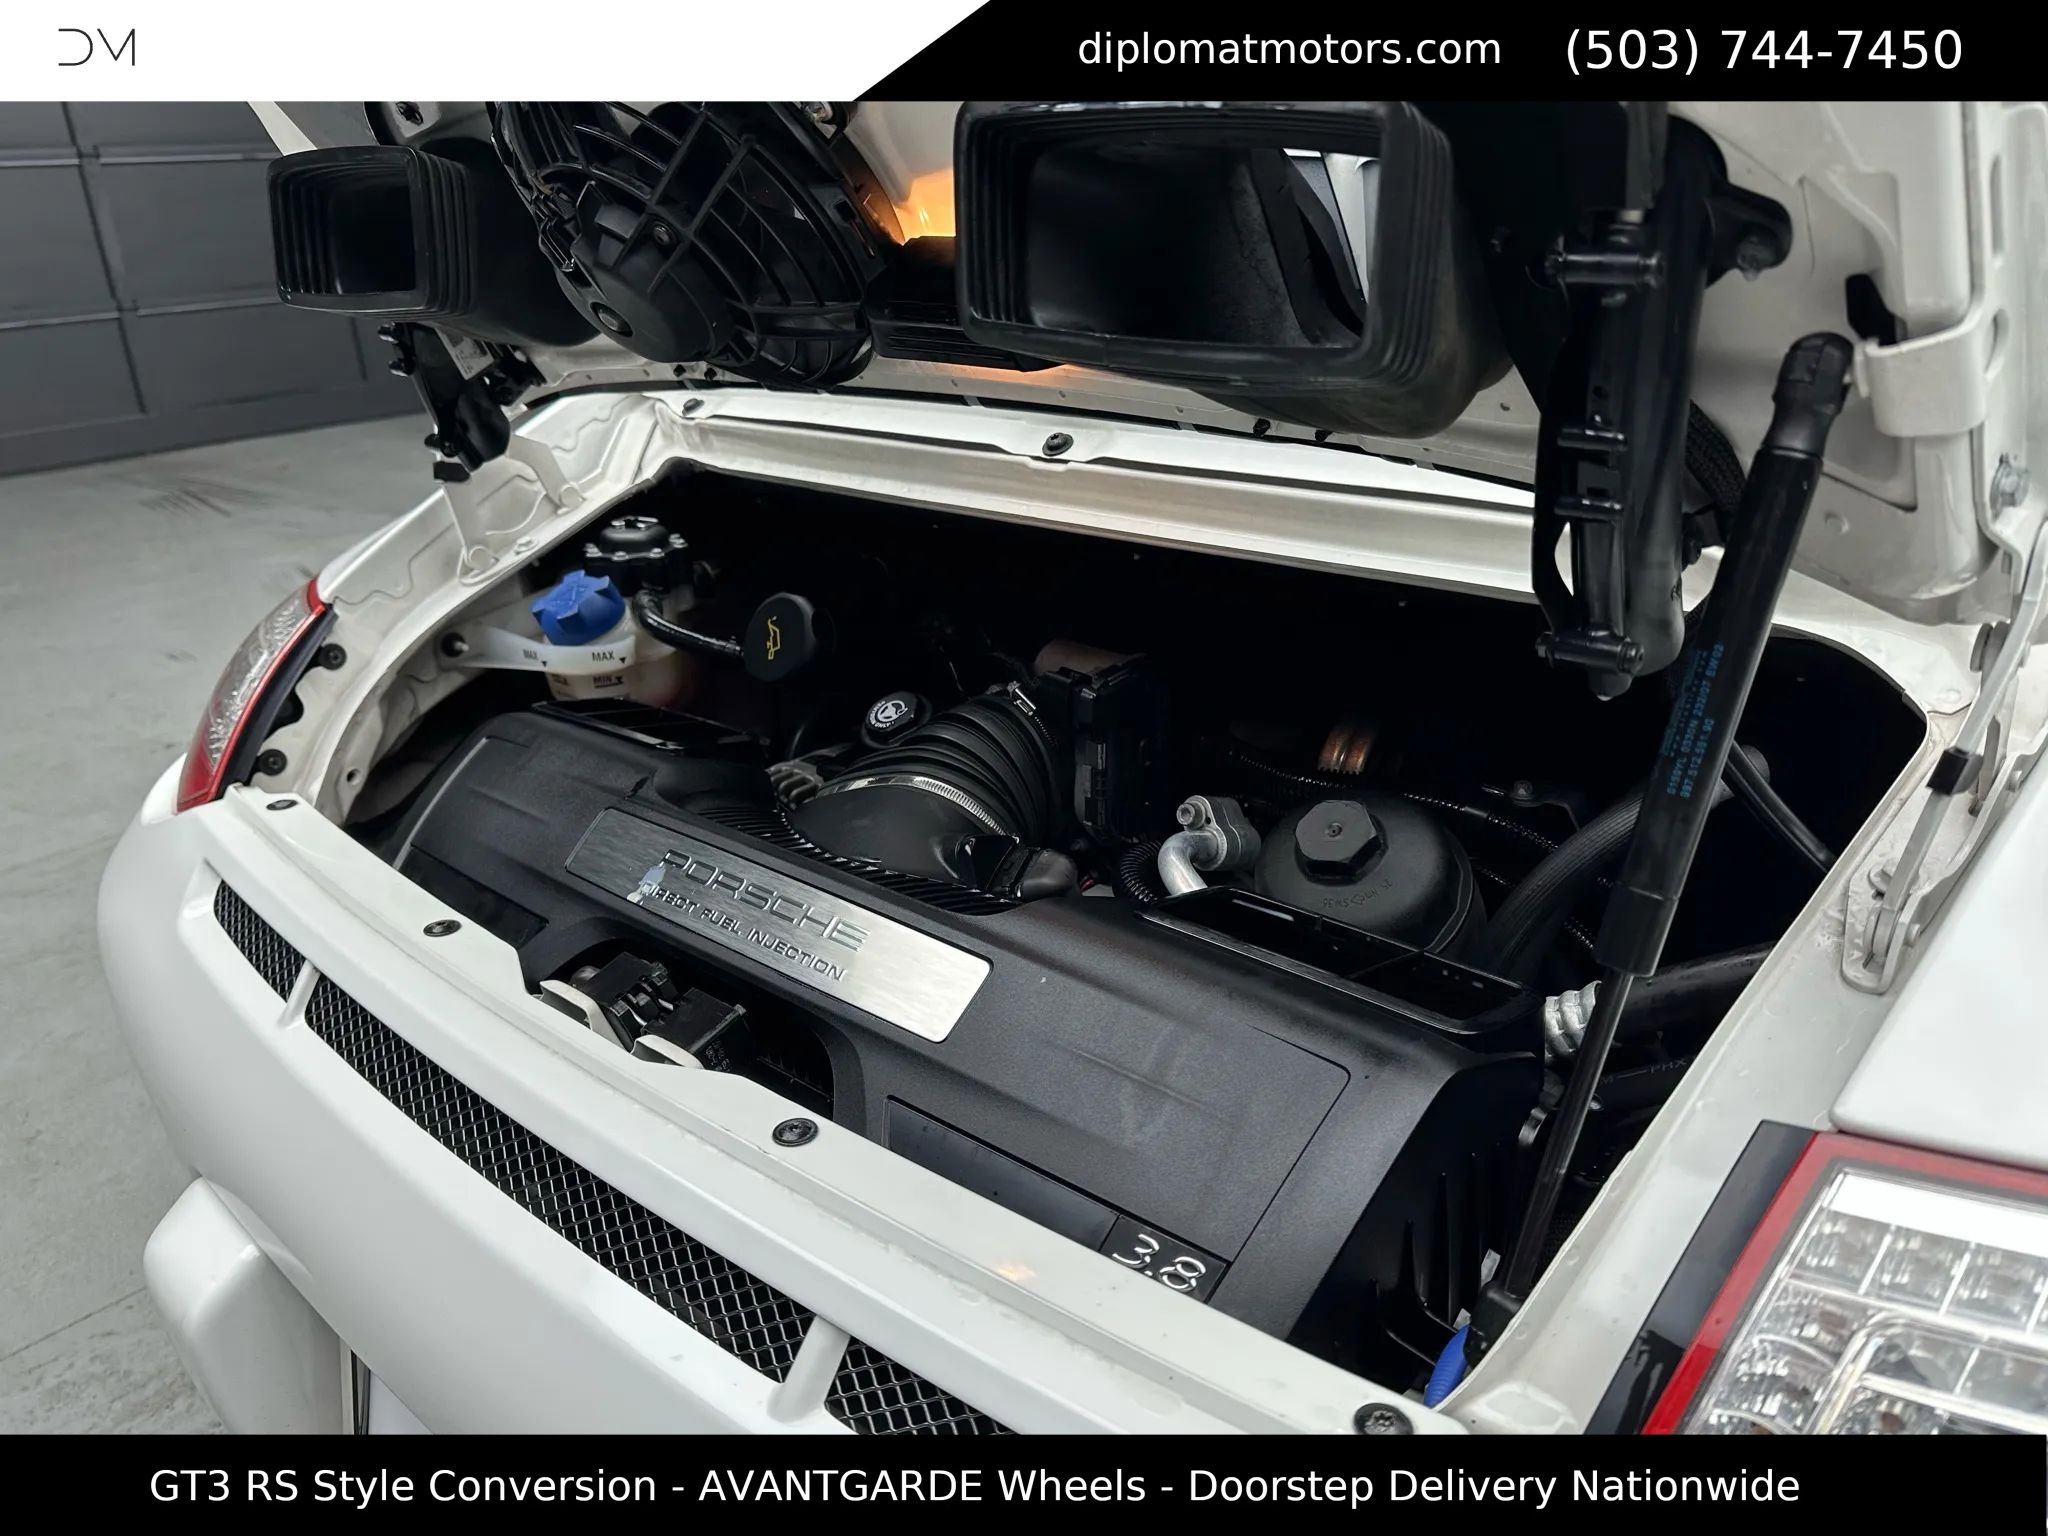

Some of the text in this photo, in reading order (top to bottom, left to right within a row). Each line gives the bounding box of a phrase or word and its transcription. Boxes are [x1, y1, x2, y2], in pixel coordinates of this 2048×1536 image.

[592, 650, 615, 662] MAX
[640, 881, 848, 981] DIRECT FUEL INJECTION
[660, 848, 870, 952] PORSCHE
[1112, 1234, 1206, 1293] 3.8
